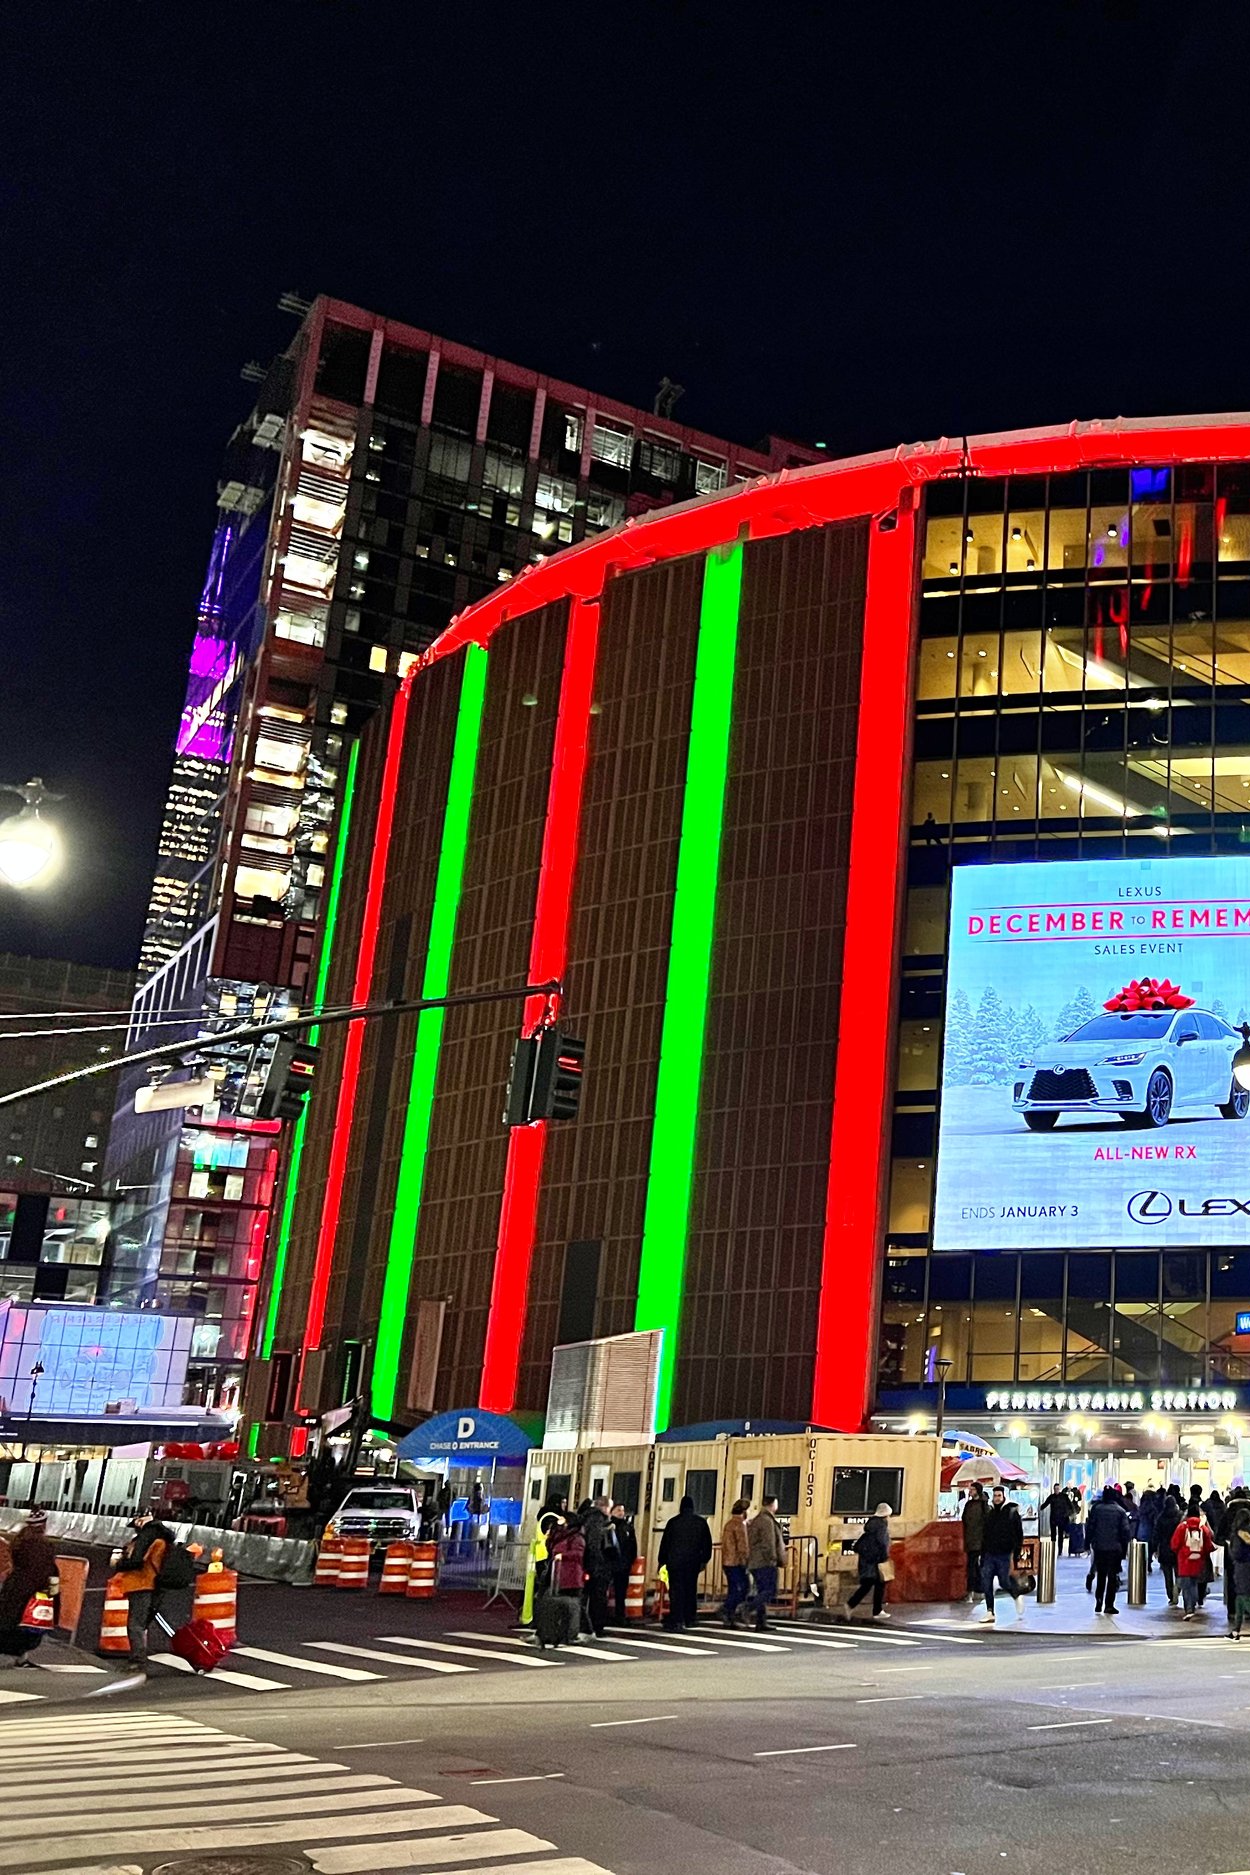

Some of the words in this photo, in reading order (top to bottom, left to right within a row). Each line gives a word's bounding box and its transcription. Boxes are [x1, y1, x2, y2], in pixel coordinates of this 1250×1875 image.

[1118, 886, 1162, 898] LEXUS
[968, 909, 1125, 936] DECEMBER
[1131, 916, 1146, 926] TO
[1094, 944, 1136, 956] SALES
[1140, 943, 1183, 955] EVENT
[1094, 1146, 1170, 1161] ALL-NEW
[1174, 1145, 1197, 1159] RX
[961, 1206, 996, 1220] ENDS
[1000, 1205, 1066, 1219] JANUARY
[1071, 1205, 1079, 1217] 3
[986, 1391, 1144, 1411] PENNSYLVANIA
[1150, 1391, 1237, 1411] STATION
[457, 1417, 475, 1439] D
[430, 1442, 451, 1450] CHASE
[459, 1441, 499, 1449] ENTRANCE
